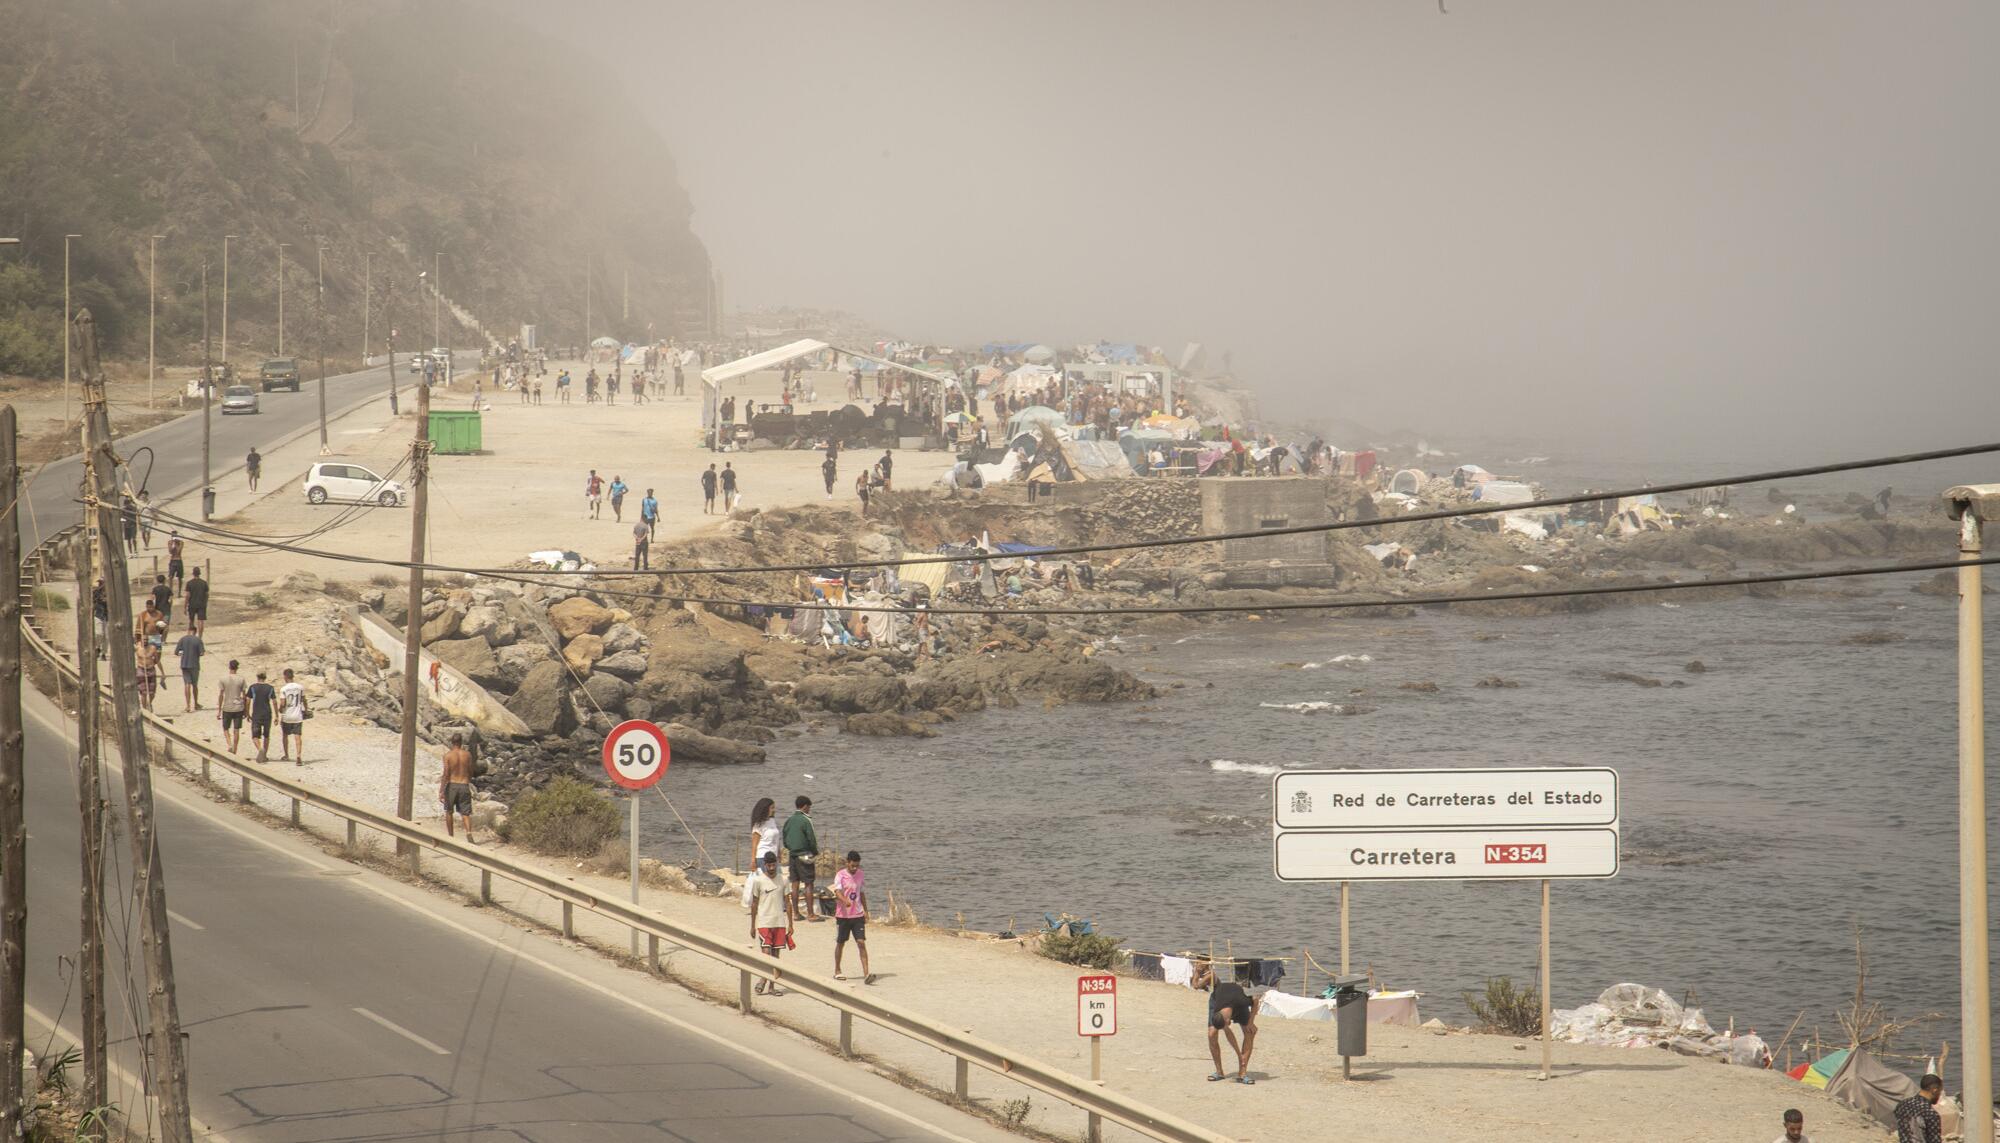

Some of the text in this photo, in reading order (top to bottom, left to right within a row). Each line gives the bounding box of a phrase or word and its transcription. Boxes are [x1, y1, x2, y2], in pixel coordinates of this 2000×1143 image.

[619, 743, 655, 766] 50
[1333, 791, 1603, 807] Red de Carreteras del Estado
[1350, 847, 1544, 865] Carretera N-354
[1081, 979, 1113, 991] N-354
[1089, 1000, 1105, 1009] km
[1091, 1013, 1104, 1028] 0
